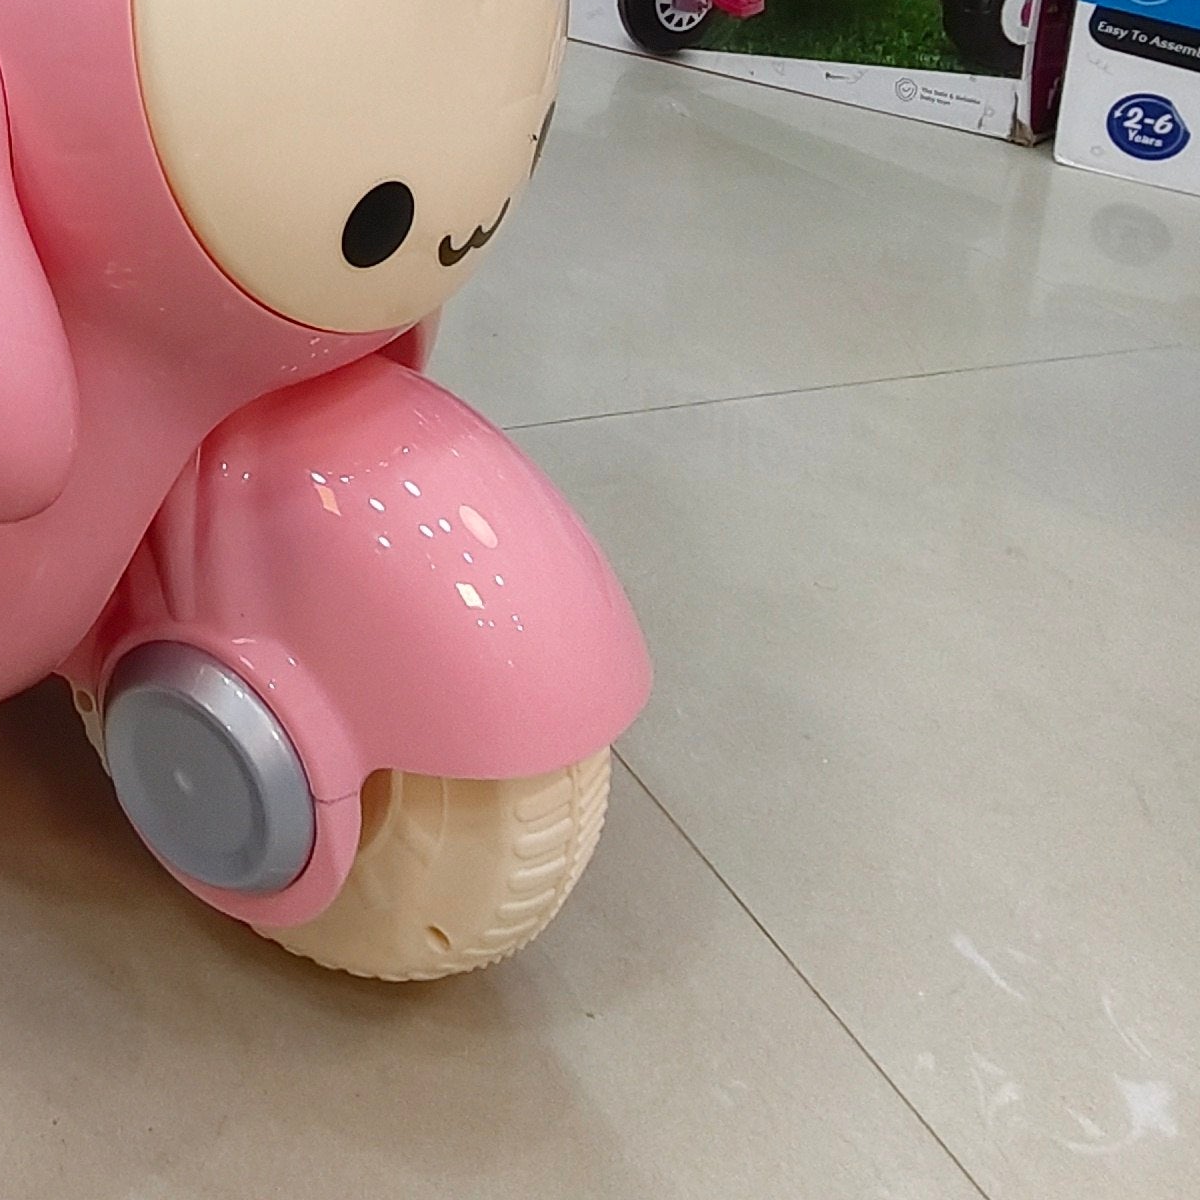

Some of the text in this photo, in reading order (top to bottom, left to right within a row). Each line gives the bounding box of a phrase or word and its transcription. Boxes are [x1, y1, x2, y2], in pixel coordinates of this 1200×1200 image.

[1097, 20, 1128, 40] Easy
[1131, 29, 1148, 43] To
[1123, 107, 1173, 134] 2-6
[1127, 128, 1163, 147] Years
